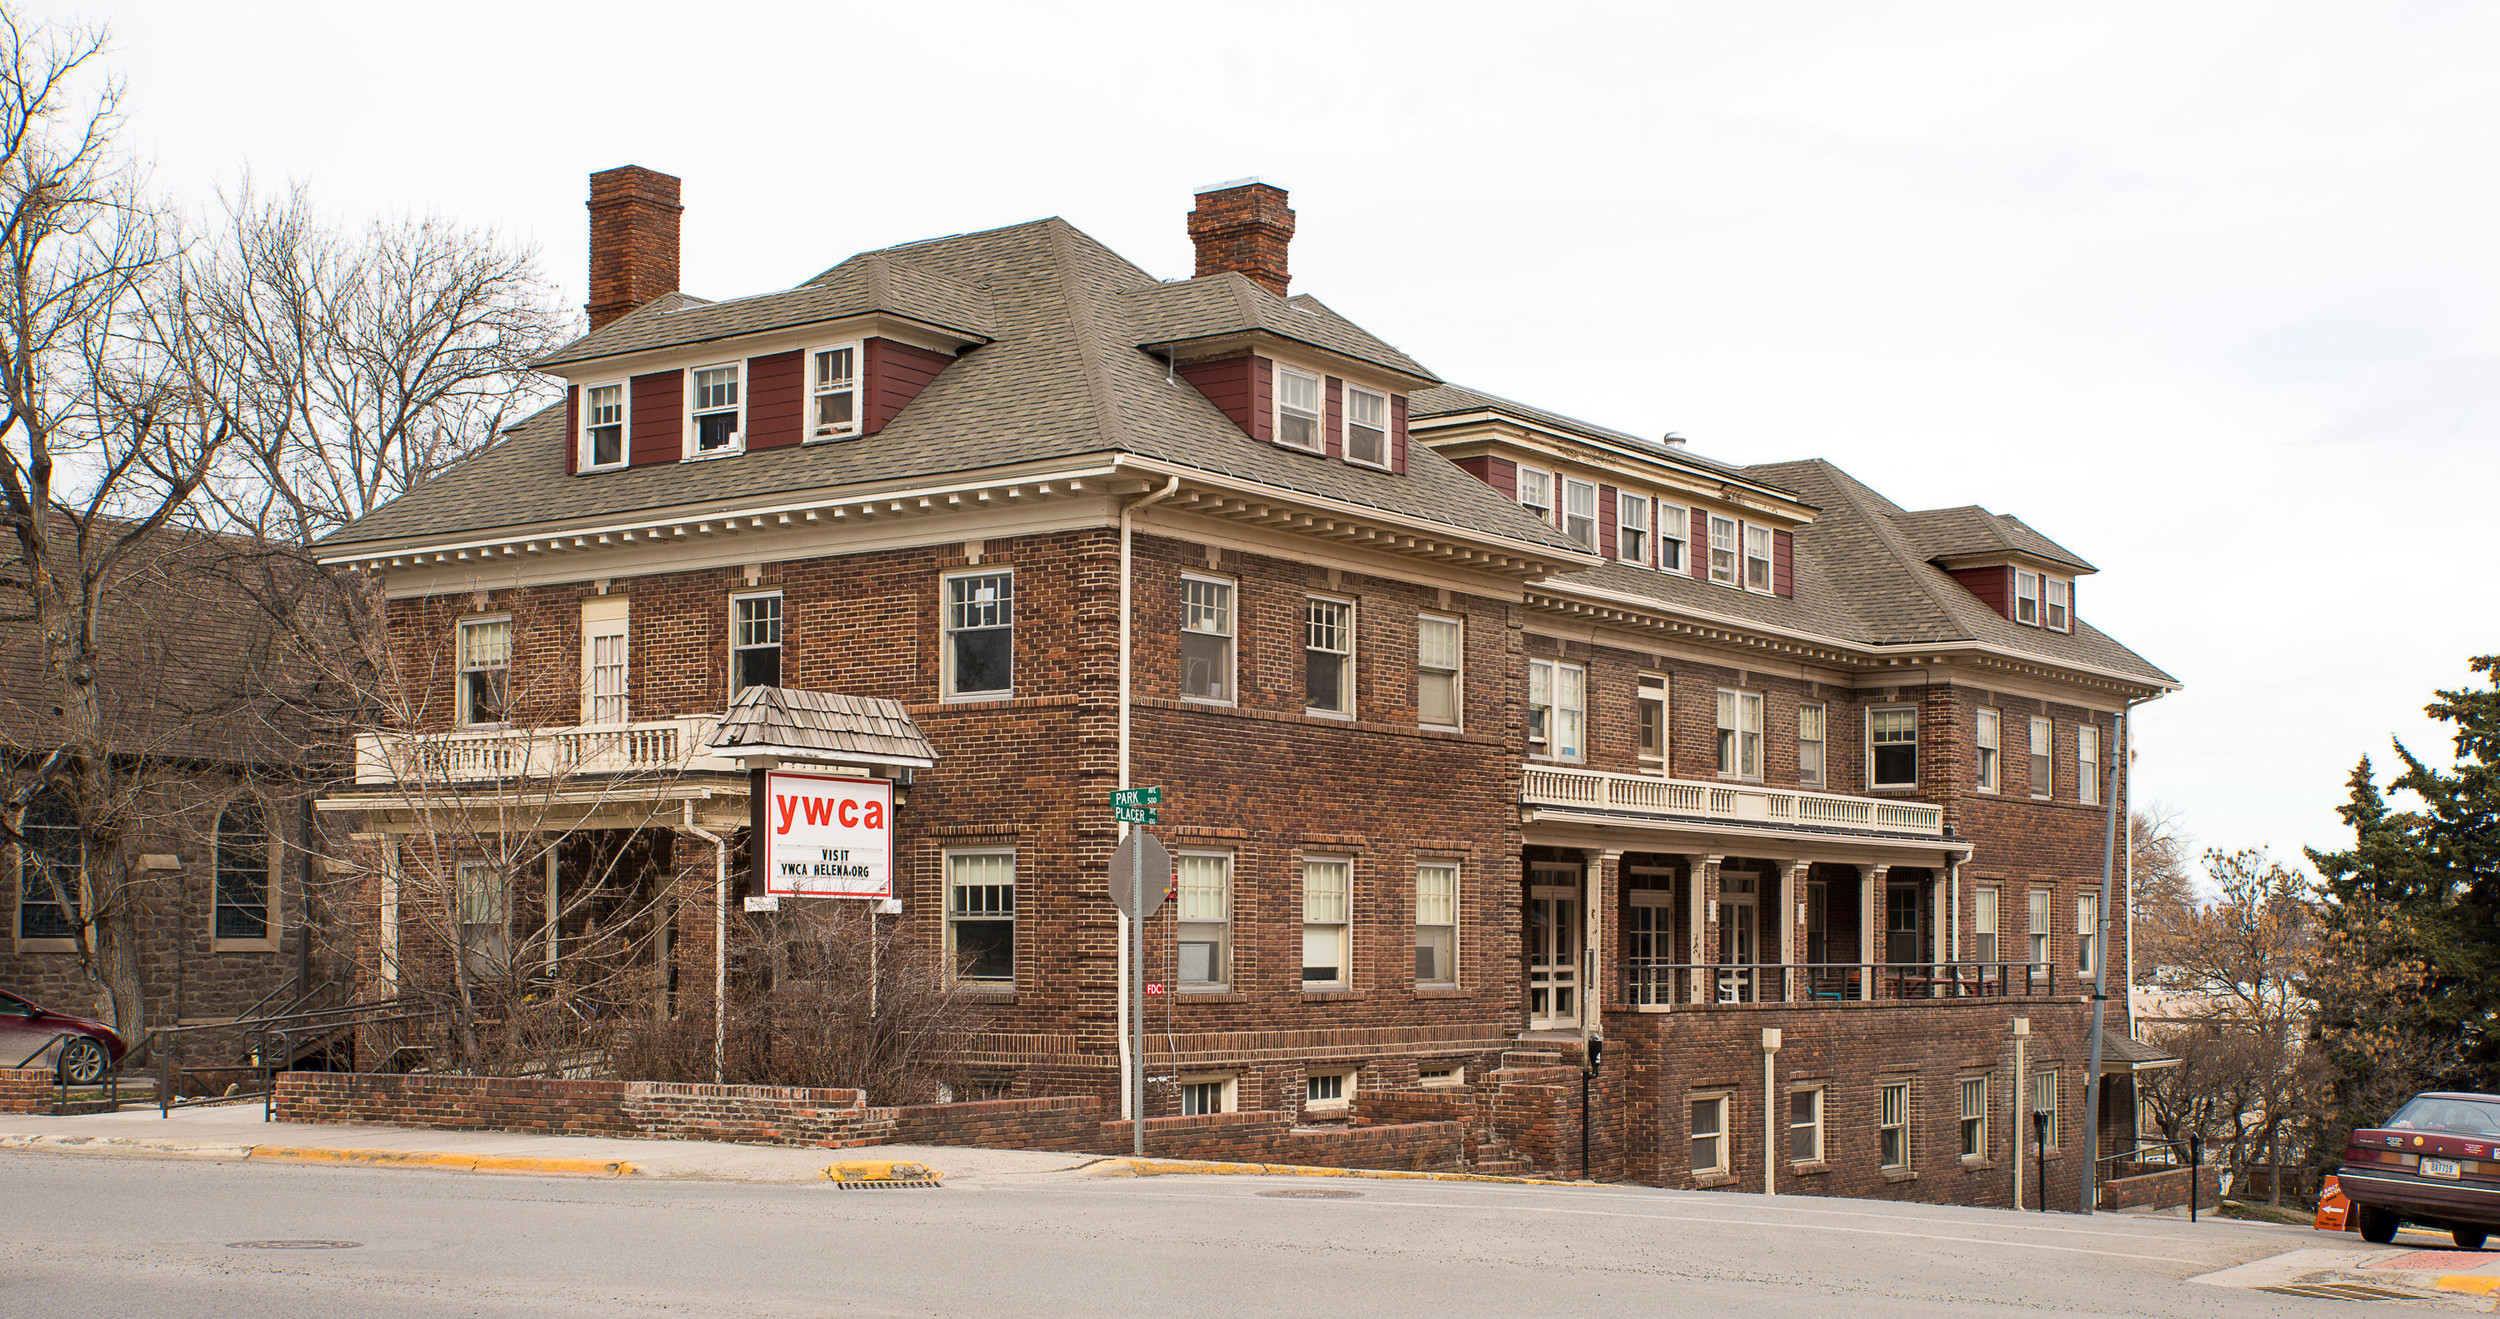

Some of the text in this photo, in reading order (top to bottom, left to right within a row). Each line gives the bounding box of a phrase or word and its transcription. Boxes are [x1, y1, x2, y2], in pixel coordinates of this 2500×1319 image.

[1115, 791, 1138, 805] PARK
[776, 794, 884, 835] ywca
[1115, 807, 1145, 821] PLACER
[822, 849, 850, 861] VISIT
[781, 863, 808, 876] YWCA
[1147, 984, 1162, 994] FDC
